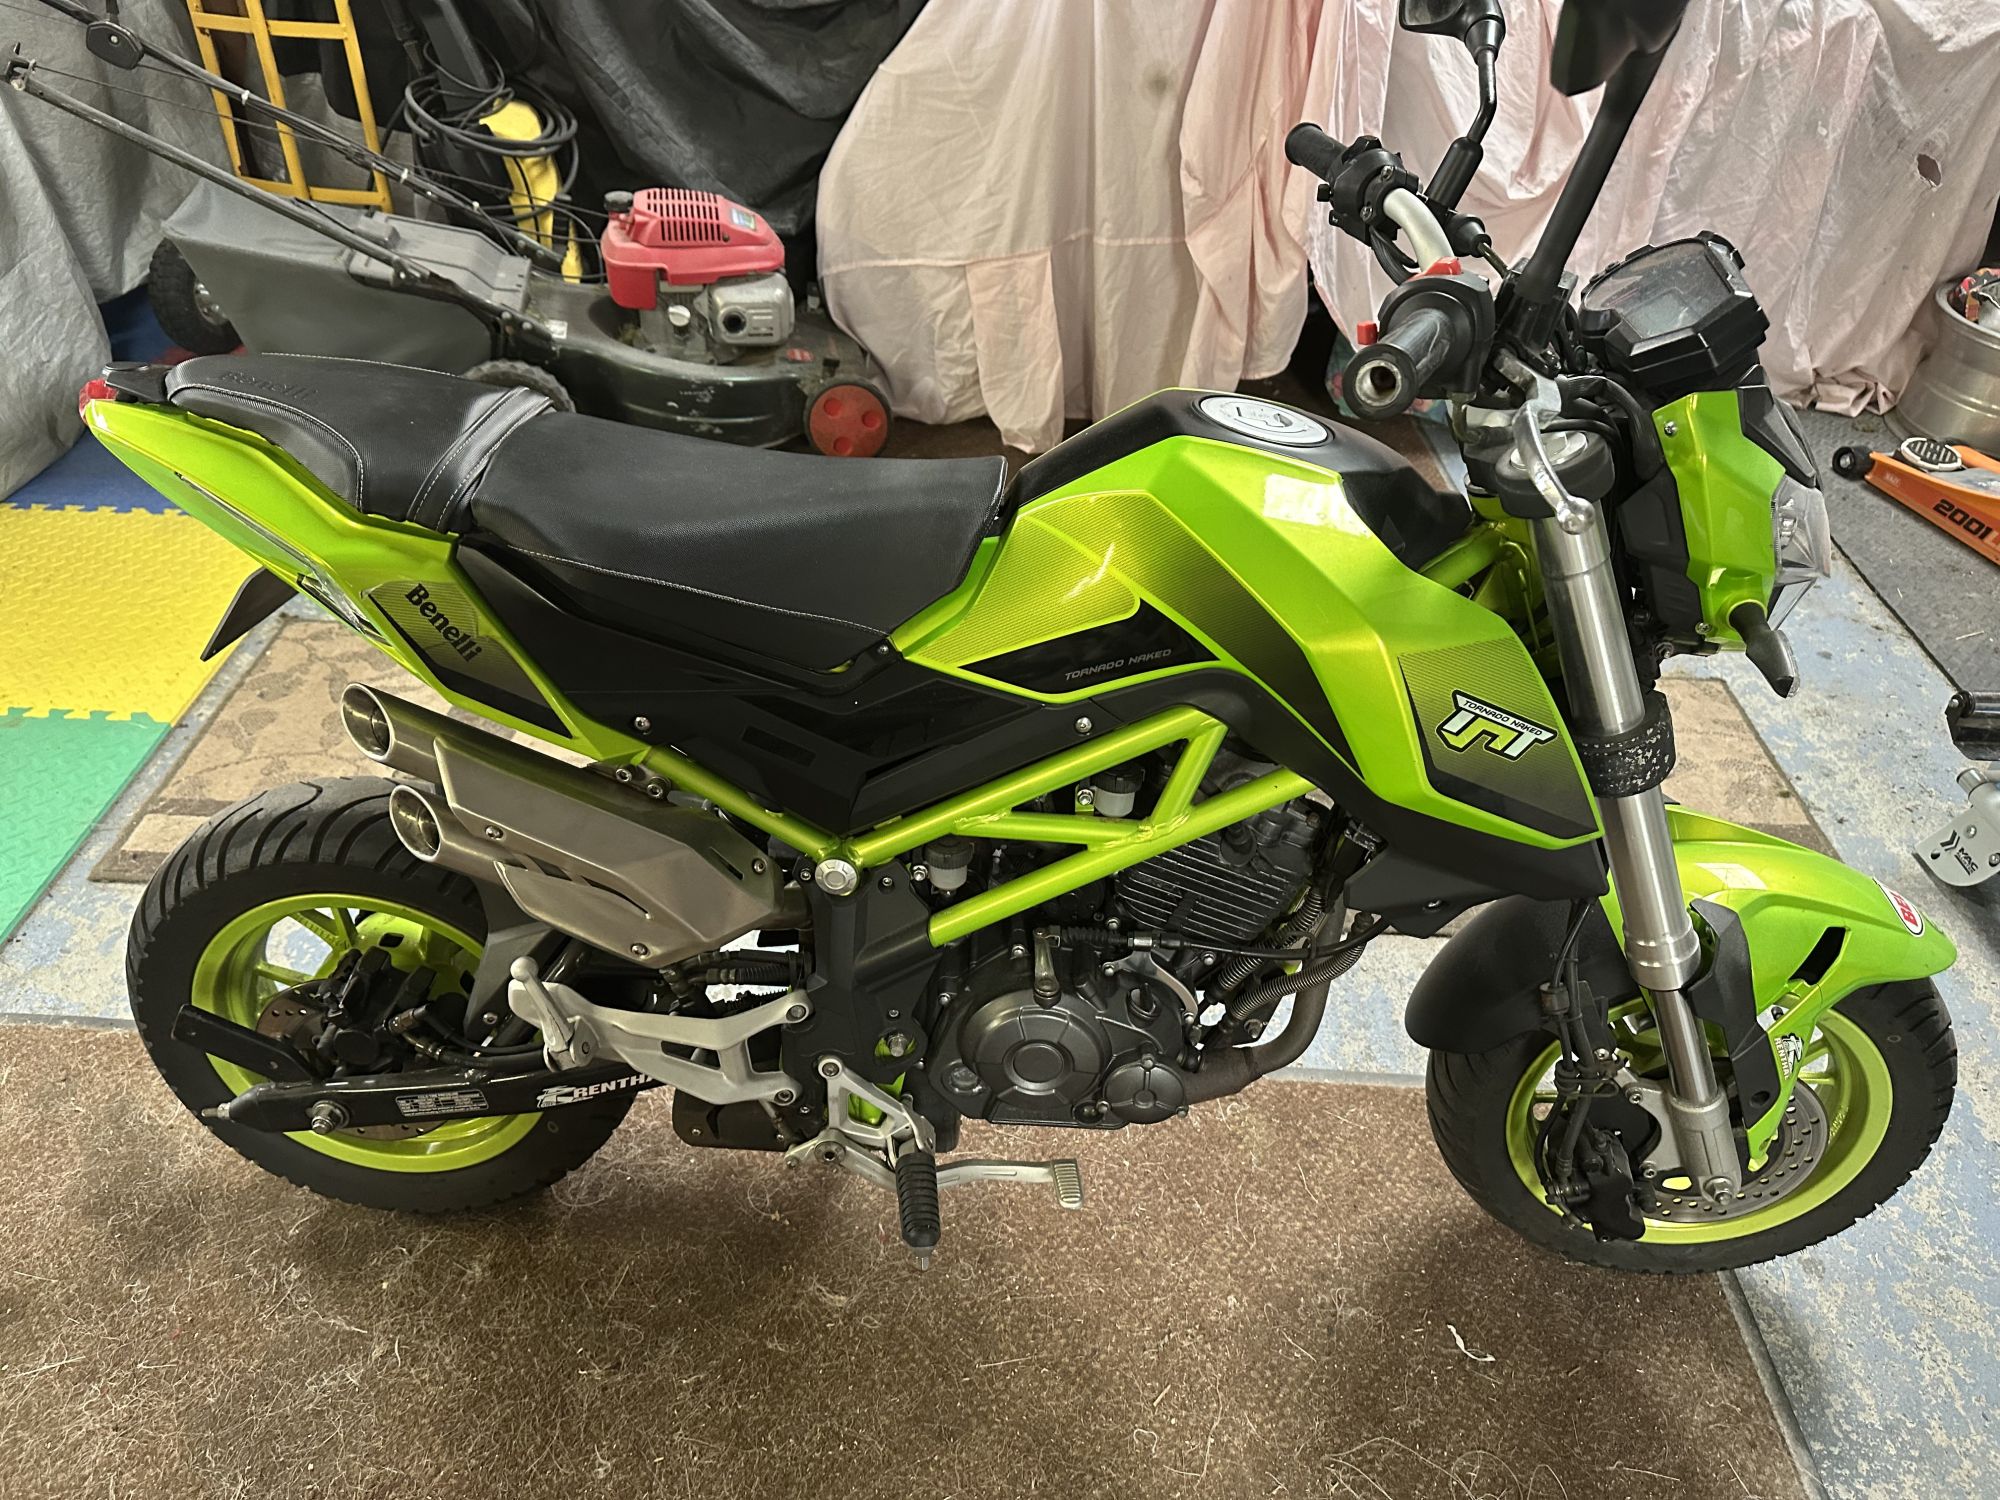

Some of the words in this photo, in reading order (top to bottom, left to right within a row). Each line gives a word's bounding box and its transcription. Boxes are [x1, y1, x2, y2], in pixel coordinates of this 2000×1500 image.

[405, 583, 482, 662] Benelli
[1065, 659, 1124, 680] TORNADO
[1128, 649, 1171, 665] NAKED
[1464, 701, 1510, 722] TORNADO
[1510, 720, 1543, 736] NAKED
[1956, 847, 1979, 871] MAC
[1774, 1038, 1789, 1080] RENTHAL
[573, 1073, 653, 1097] RENTH
